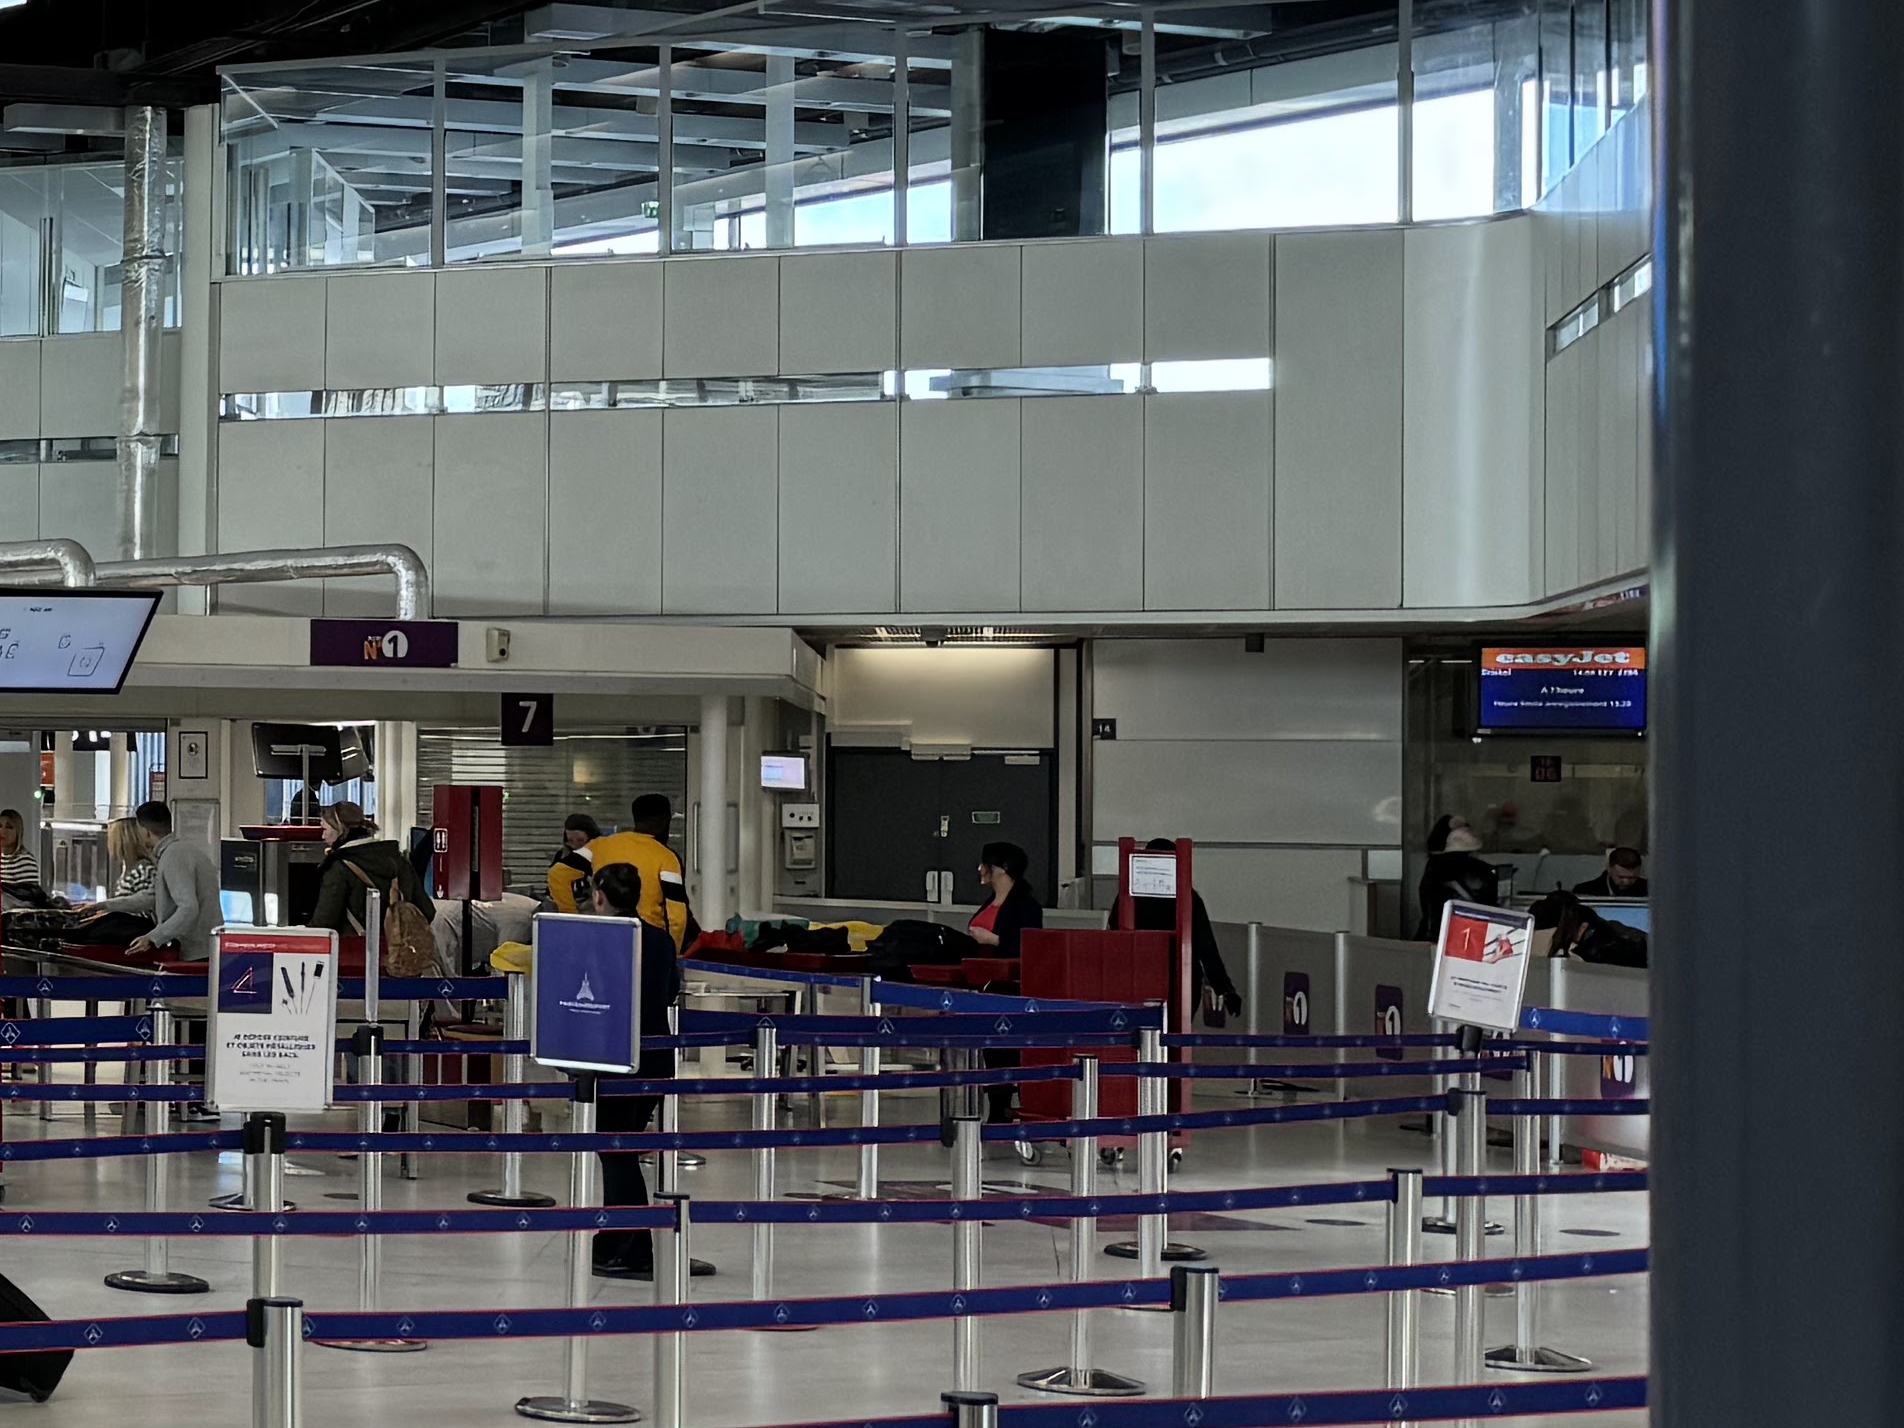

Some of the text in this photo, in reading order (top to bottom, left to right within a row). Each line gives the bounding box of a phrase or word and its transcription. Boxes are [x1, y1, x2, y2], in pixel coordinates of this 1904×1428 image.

[1495, 650, 1630, 666] easyJet
[518, 700, 538, 733] 7
[1460, 927, 1472, 953] 1
[231, 966, 258, 1000] 4
